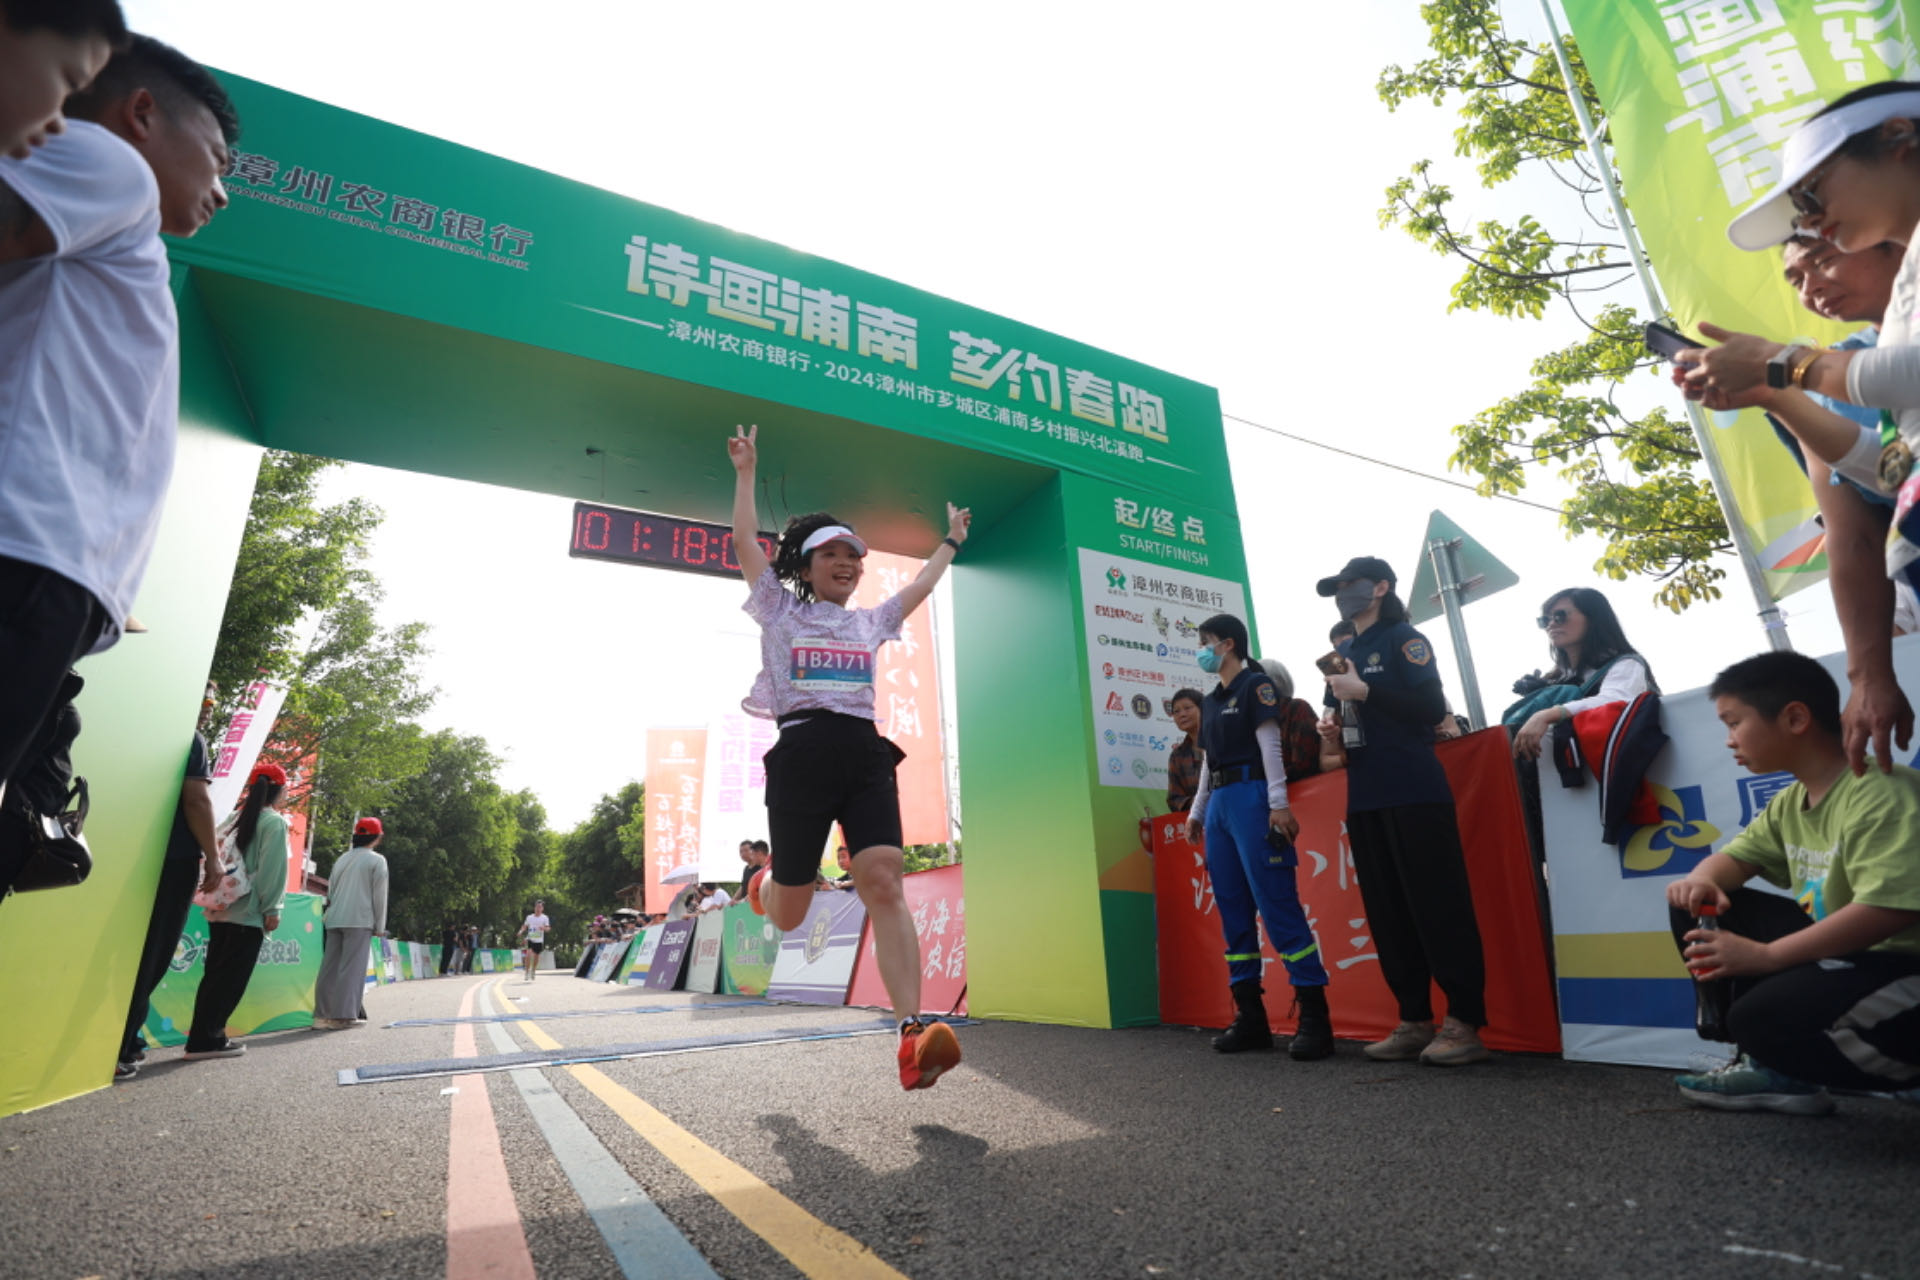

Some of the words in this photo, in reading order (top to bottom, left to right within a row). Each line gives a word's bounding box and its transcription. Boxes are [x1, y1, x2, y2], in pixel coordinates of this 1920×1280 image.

[223, 148, 534, 257] 漳州农商银行
[328, 210, 382, 233] RURAL
[384, 225, 486, 261] COMMERCIAL
[487, 252, 530, 271] BANK
[624, 235, 918, 371] 诗画浦南
[949, 330, 1170, 444] 芗约春跑
[1119, 534, 1209, 567] START/FINISH
[1131, 574, 1224, 608] 漳州农商银行
[809, 650, 865, 671] B2171
